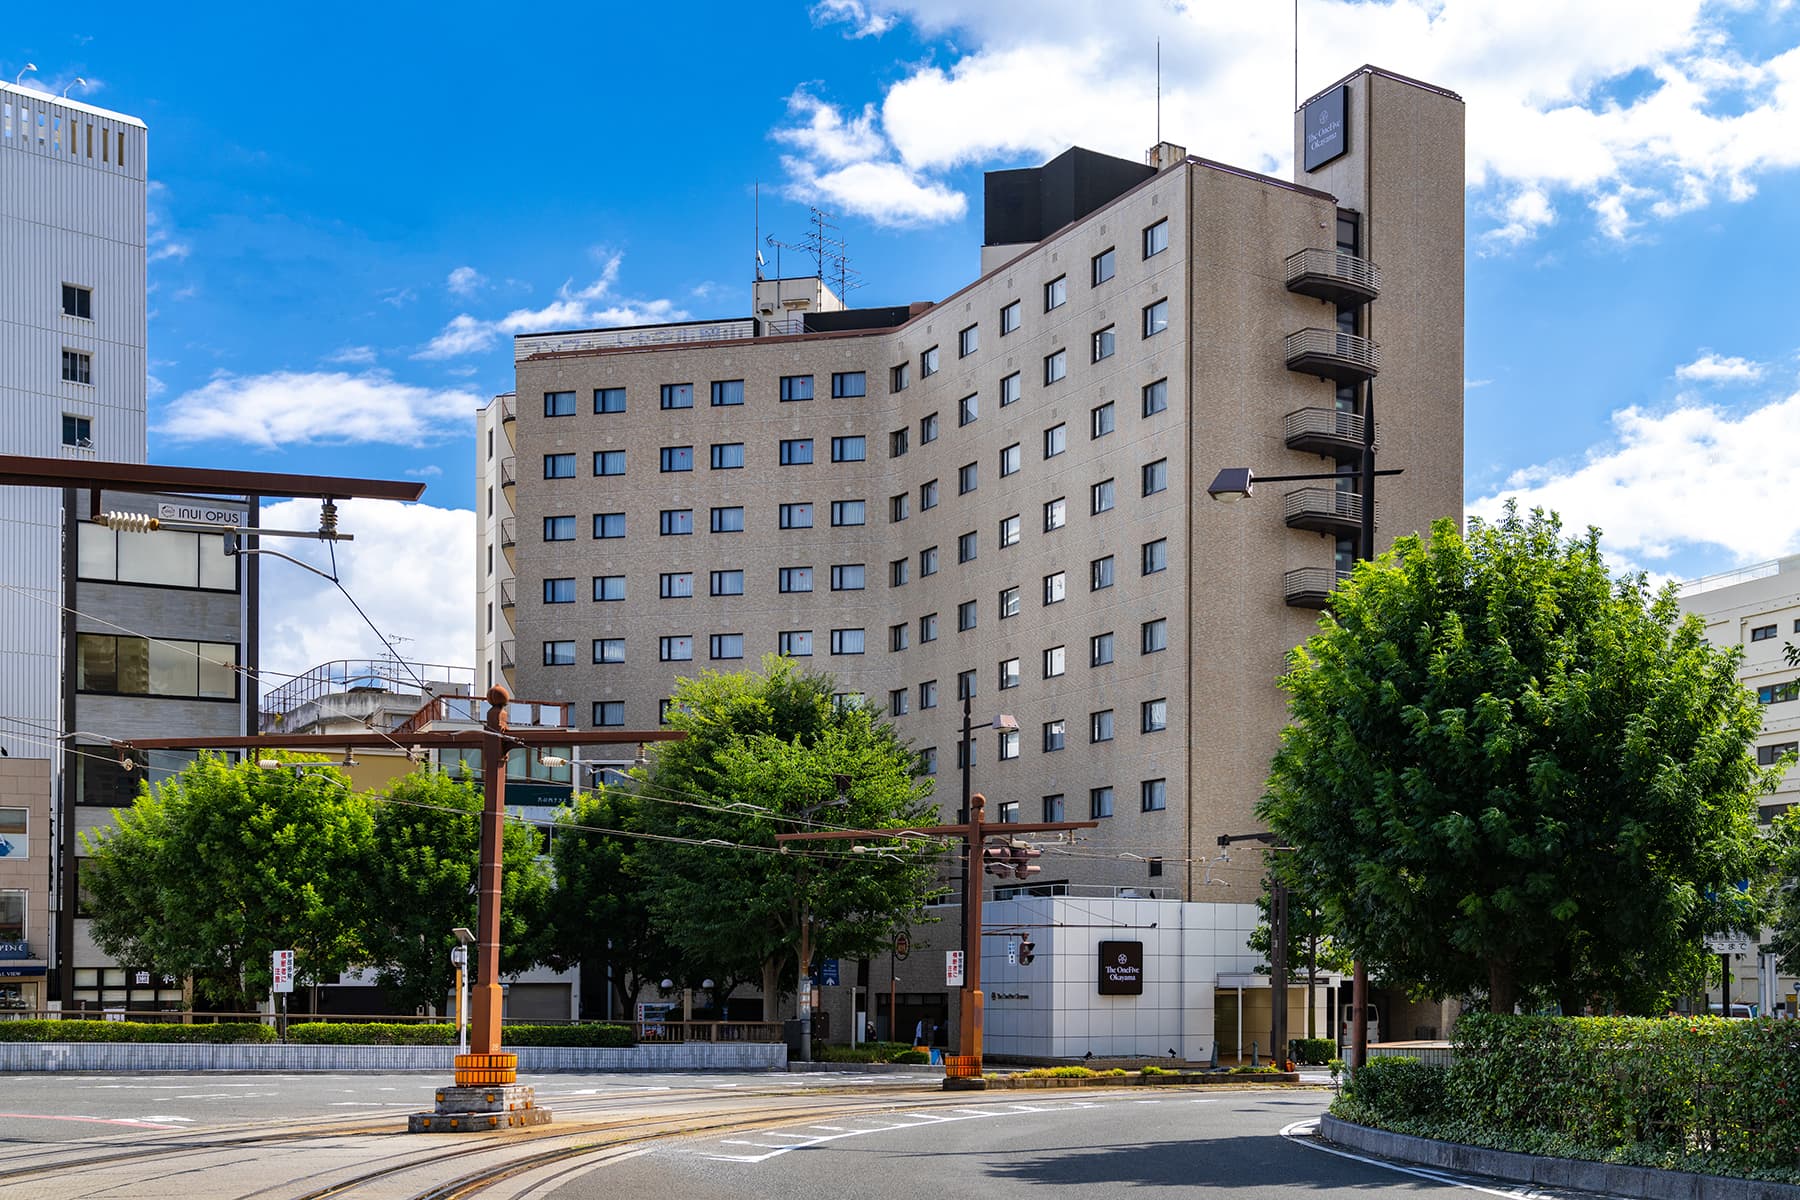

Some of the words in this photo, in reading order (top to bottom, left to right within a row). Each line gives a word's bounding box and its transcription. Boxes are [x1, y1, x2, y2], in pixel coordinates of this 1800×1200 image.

[178, 507, 202, 520] INUI
[205, 511, 240, 524] OPUS
[1109, 973, 1136, 982] Okayama
